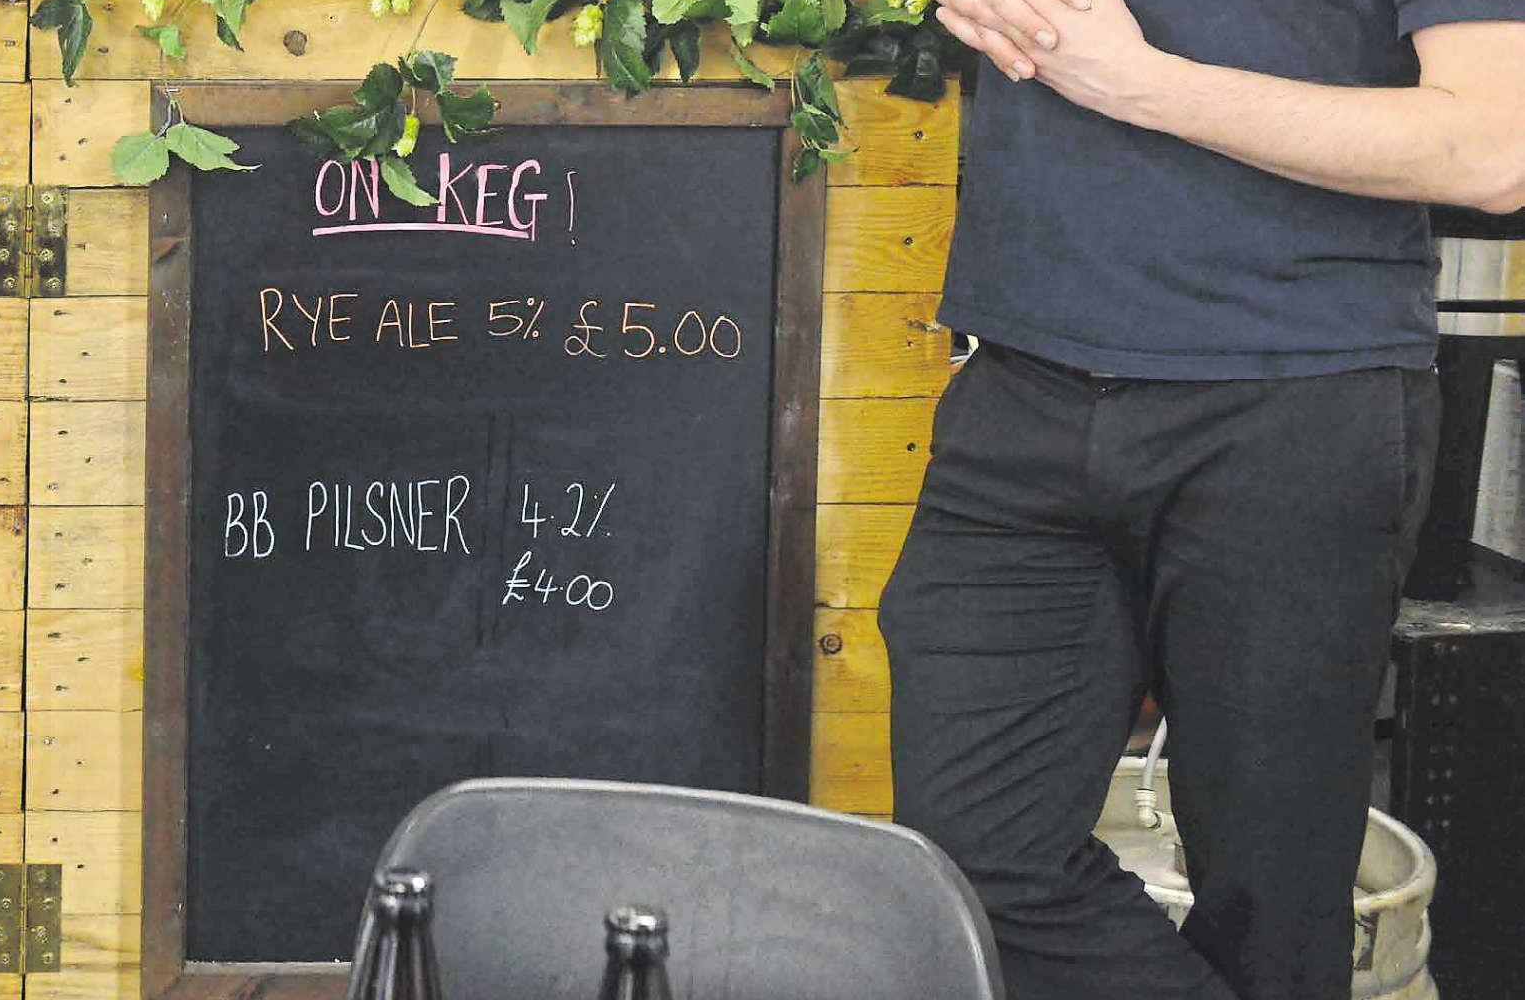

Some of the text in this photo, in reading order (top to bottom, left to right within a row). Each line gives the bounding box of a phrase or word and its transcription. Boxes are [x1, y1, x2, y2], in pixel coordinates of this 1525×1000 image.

[313, 158, 379, 220] ON
[260, 287, 742, 359] RYE ALE 5% £5.00
[224, 474, 616, 560] BB PILSNER 4.2%
[501, 550, 615, 610] £4.00
